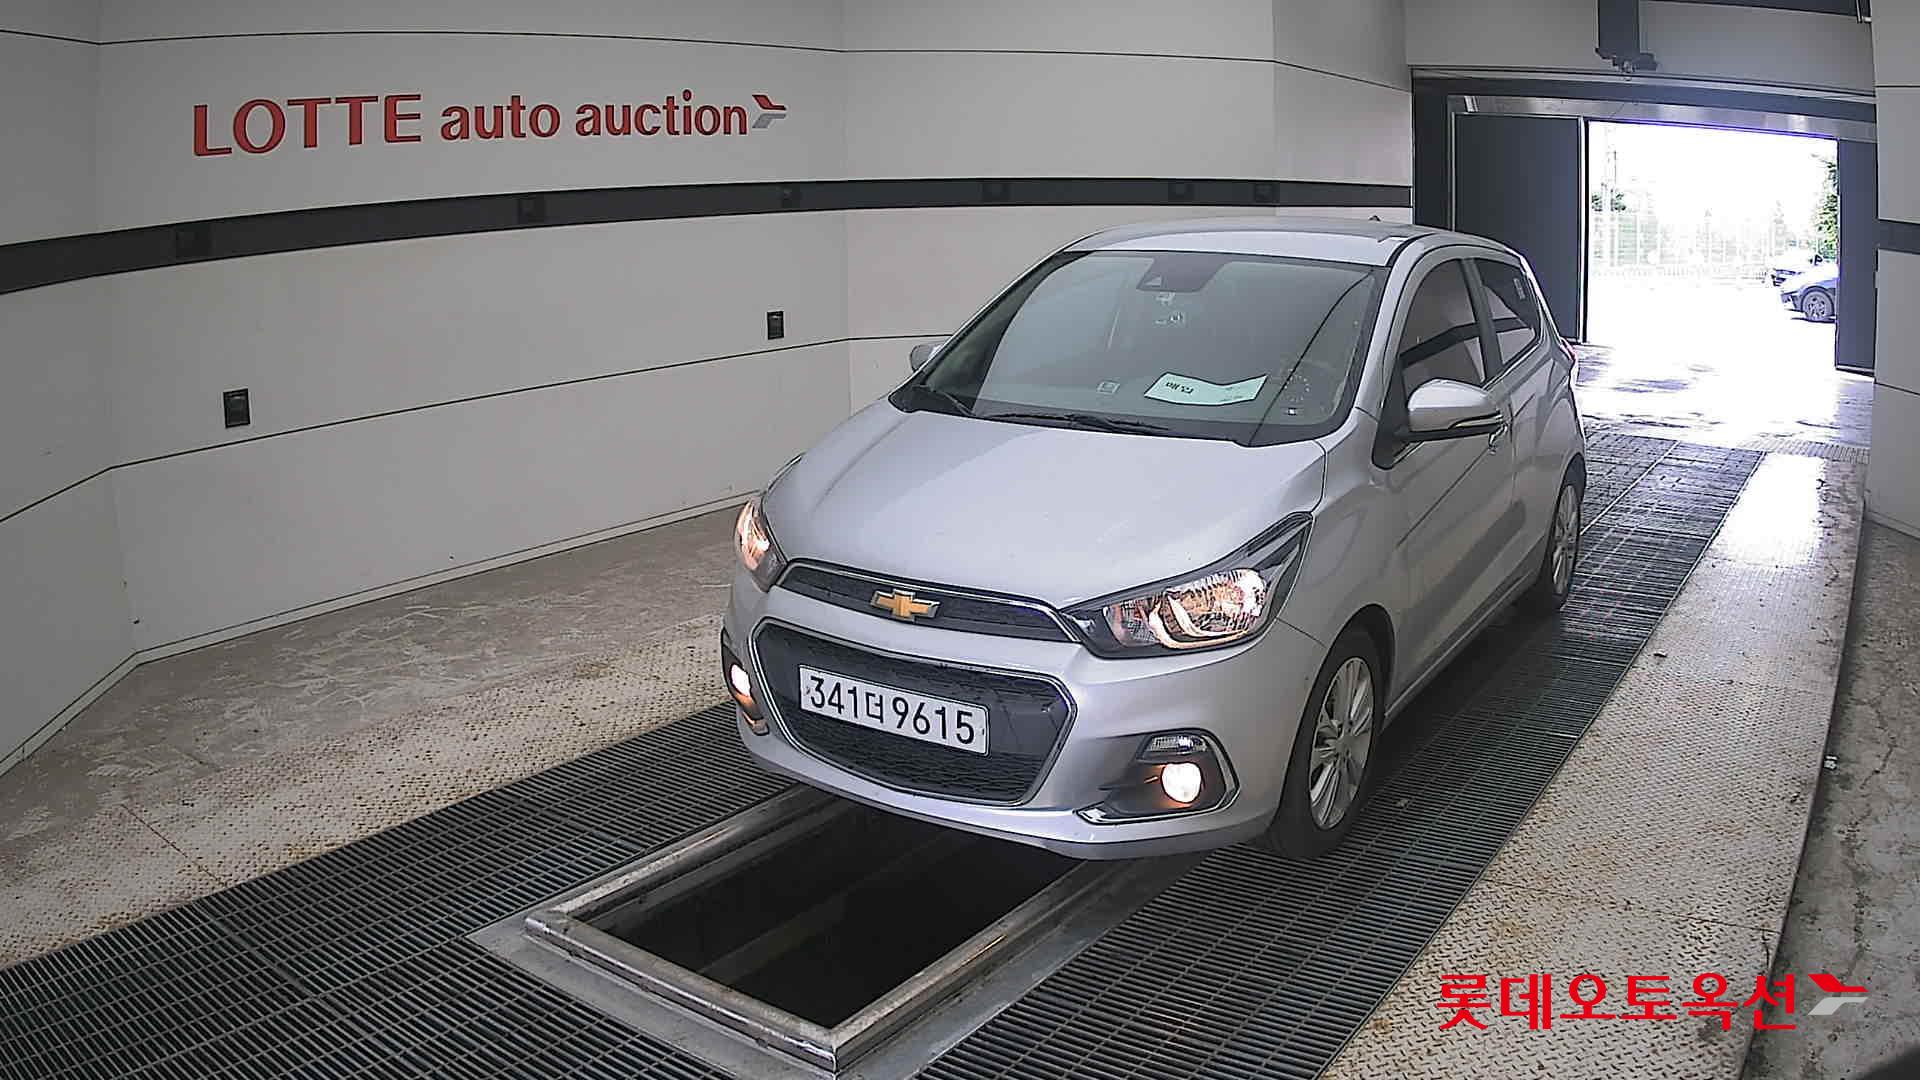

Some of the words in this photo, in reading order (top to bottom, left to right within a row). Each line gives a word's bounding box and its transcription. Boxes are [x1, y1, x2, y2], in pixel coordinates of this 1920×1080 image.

[192, 95, 422, 157] LOTTE
[440, 96, 560, 140] auto
[575, 89, 748, 135] auction
